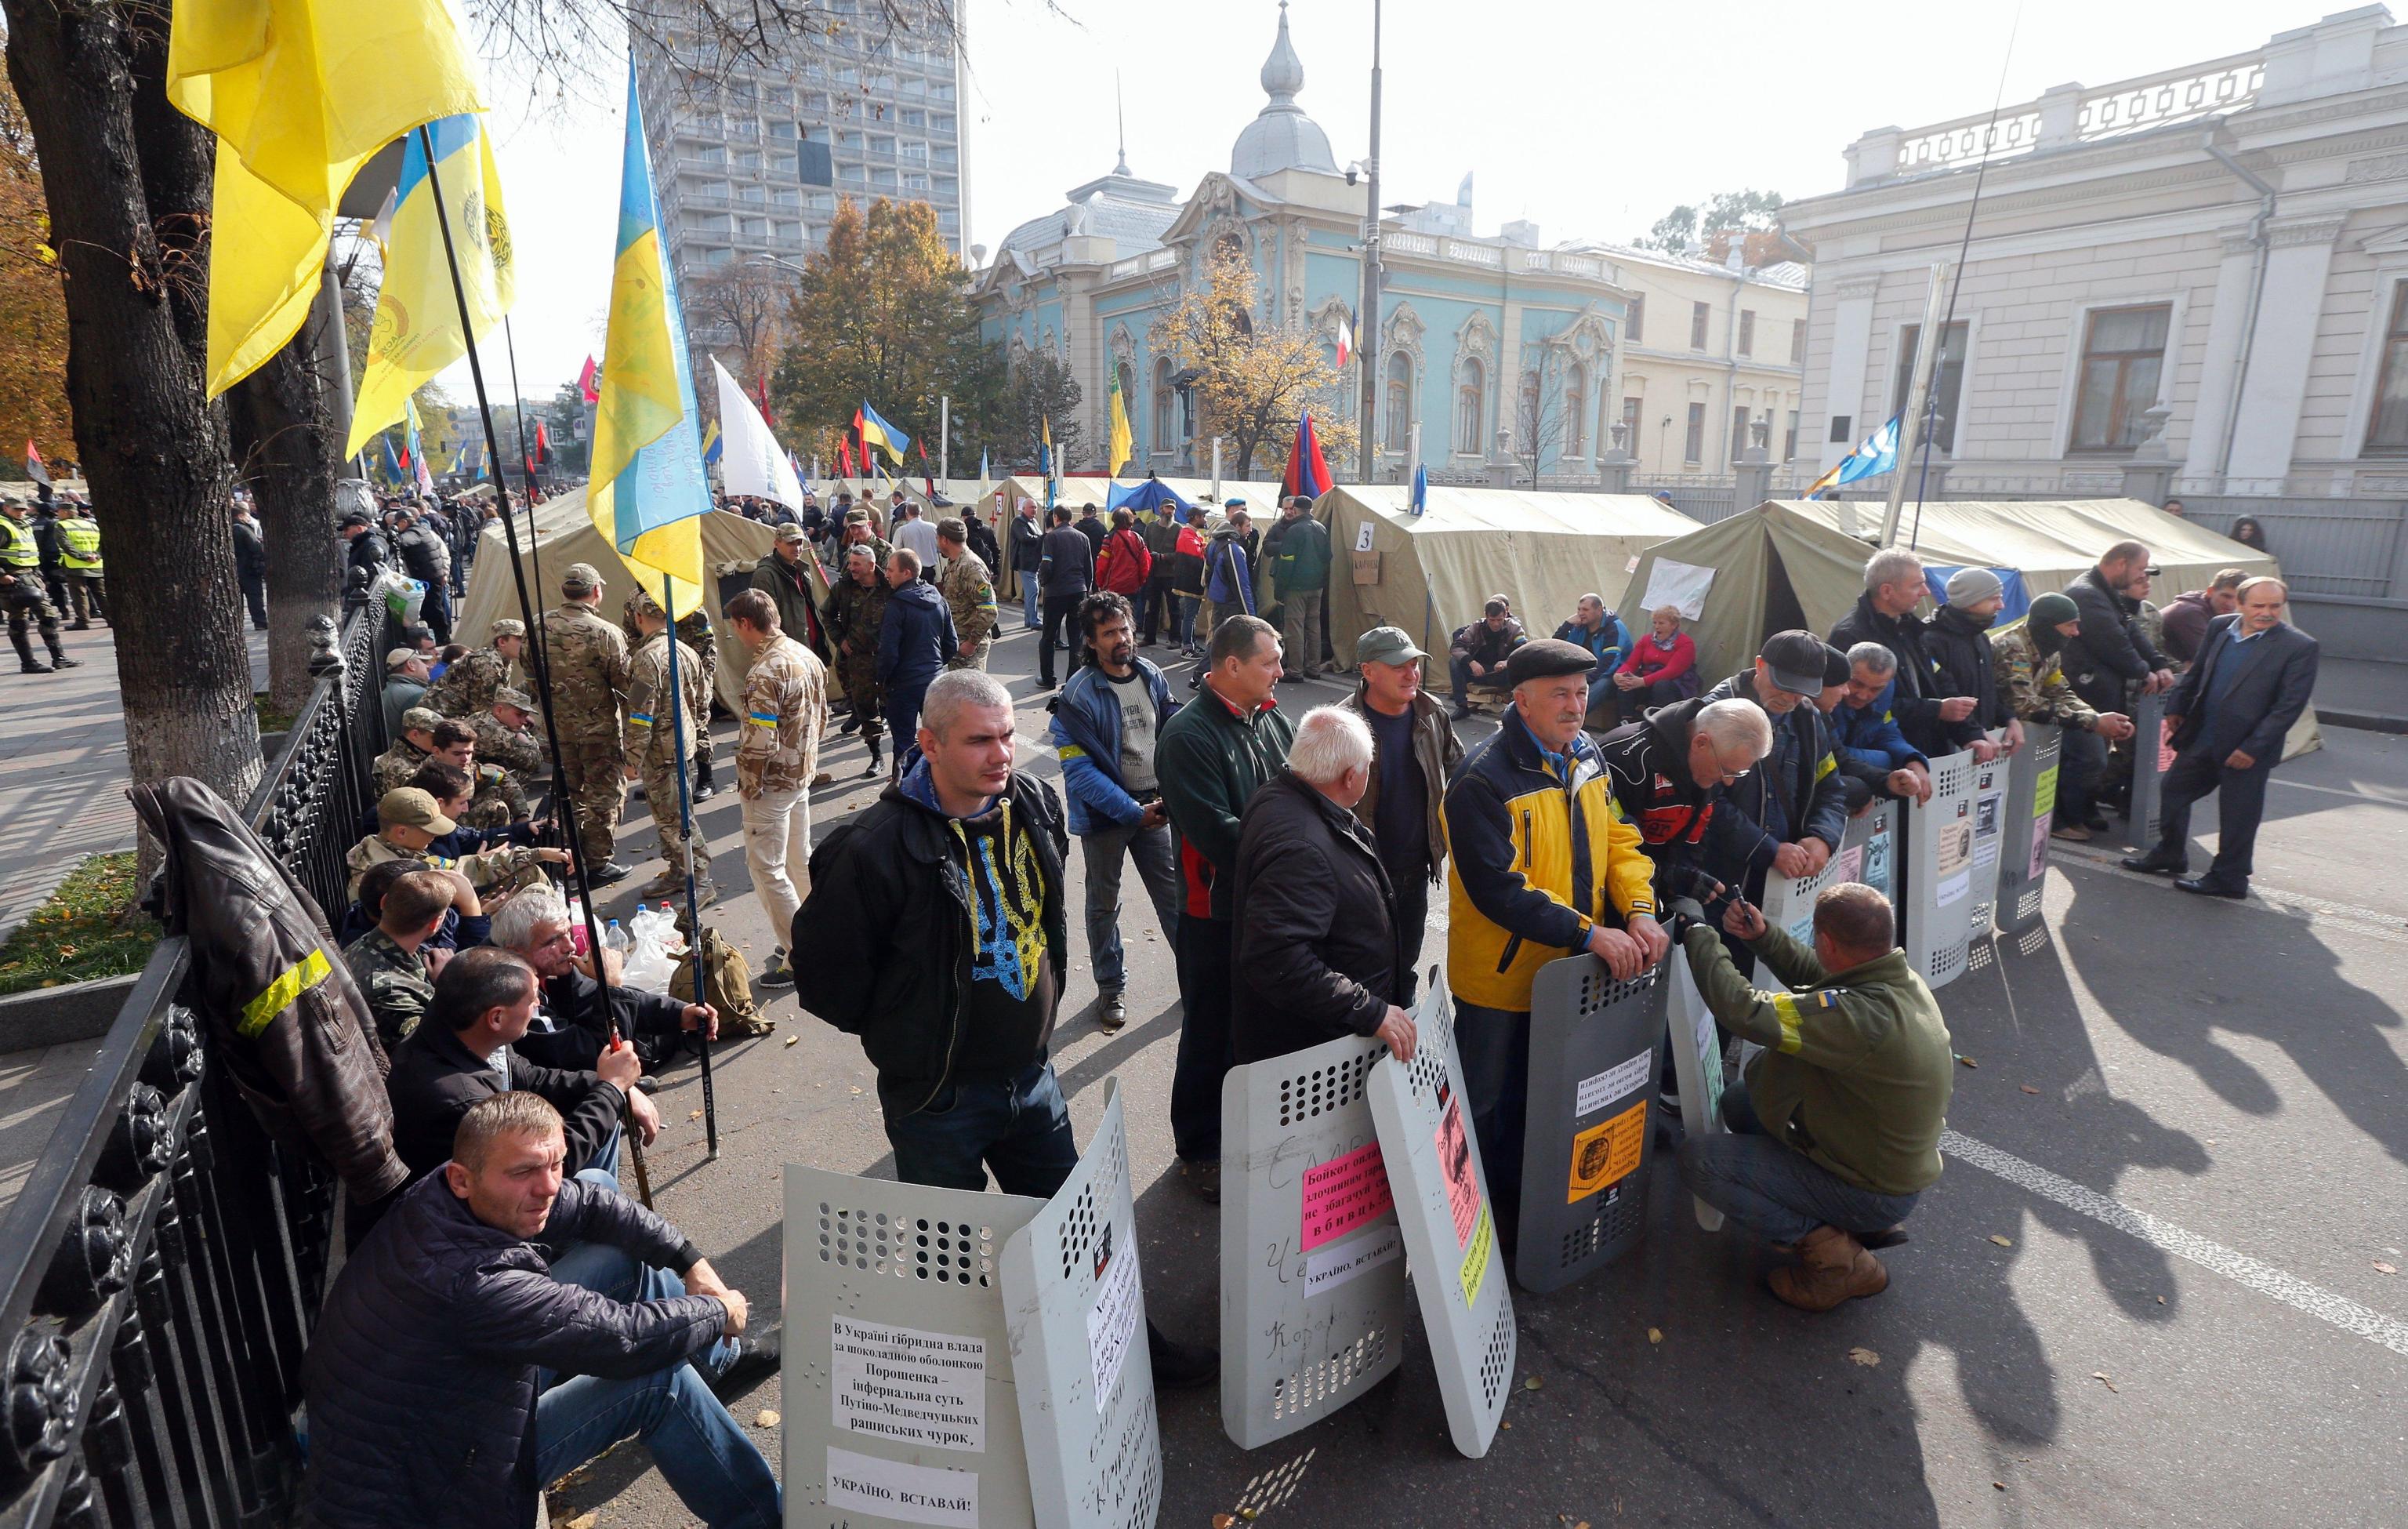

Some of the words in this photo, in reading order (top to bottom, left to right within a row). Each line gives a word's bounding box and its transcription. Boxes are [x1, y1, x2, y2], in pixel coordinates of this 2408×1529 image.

[1361, 530, 1369, 548] 3
[1306, 1174, 1362, 1204] злочинним
[1307, 1162, 1349, 1186] Бойкот
[1304, 1209, 1318, 1221] не
[1324, 1185, 1370, 1215] збагачуй
[1309, 1262, 1352, 1286] УКРАЇНО,
[1355, 1240, 1396, 1266] ВСТАВАЙ!
[834, 1322, 842, 1335] В
[844, 1324, 888, 1343] Україні
[891, 1334, 944, 1350] гібридна
[947, 1341, 983, 1354] влада
[834, 1342, 844, 1352] за
[847, 1345, 916, 1364] шоколадною
[919, 1355, 983, 1371] оболонкою
[865, 1363, 938, 1385] Порошенка
[853, 1379, 931, 1402] інфернальна
[935, 1394, 963, 1407] суть
[840, 1394, 978, 1425] Путіно-Медведчуцьких
[850, 1417, 923, 1439] рашиських
[927, 1430, 974, 1447] чурок,
[832, 1476, 894, 1501] УКРАЇНО,
[901, 1491, 971, 1512] ВСТАВАЙ!
